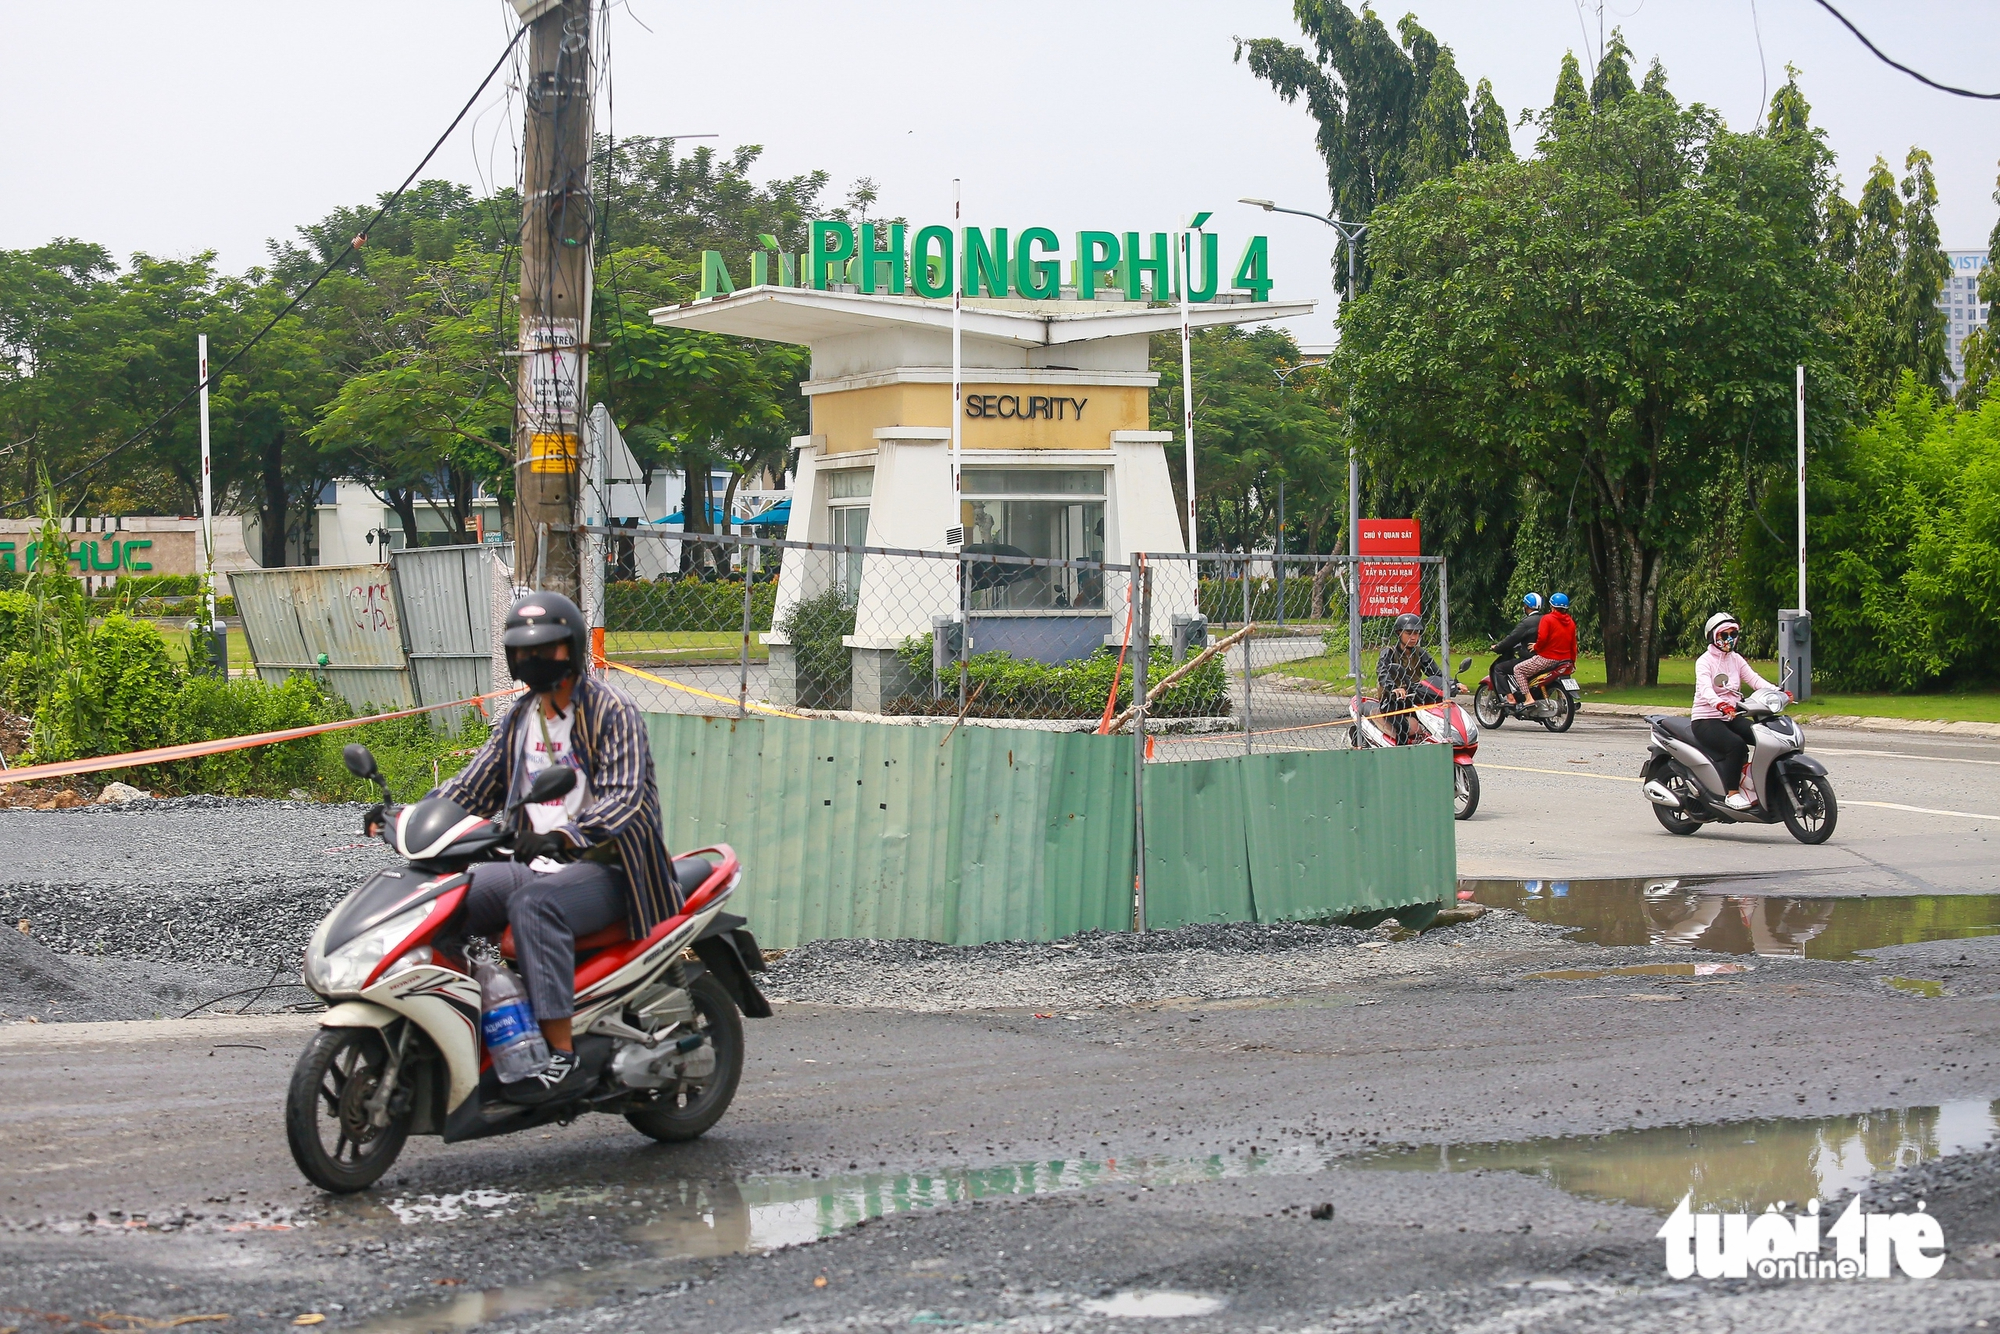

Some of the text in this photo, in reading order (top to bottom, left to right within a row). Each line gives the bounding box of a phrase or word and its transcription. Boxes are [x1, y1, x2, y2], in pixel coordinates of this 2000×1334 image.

[809, 219, 1061, 300] PHONG
[1075, 211, 1219, 303] PHÚ
[1231, 236, 1273, 302] 4
[965, 394, 1088, 420] SECURITY
[548, 449, 564, 462] 15
[1384, 531, 1400, 540] QUAN
[1401, 530, 1412, 539] SÁT
